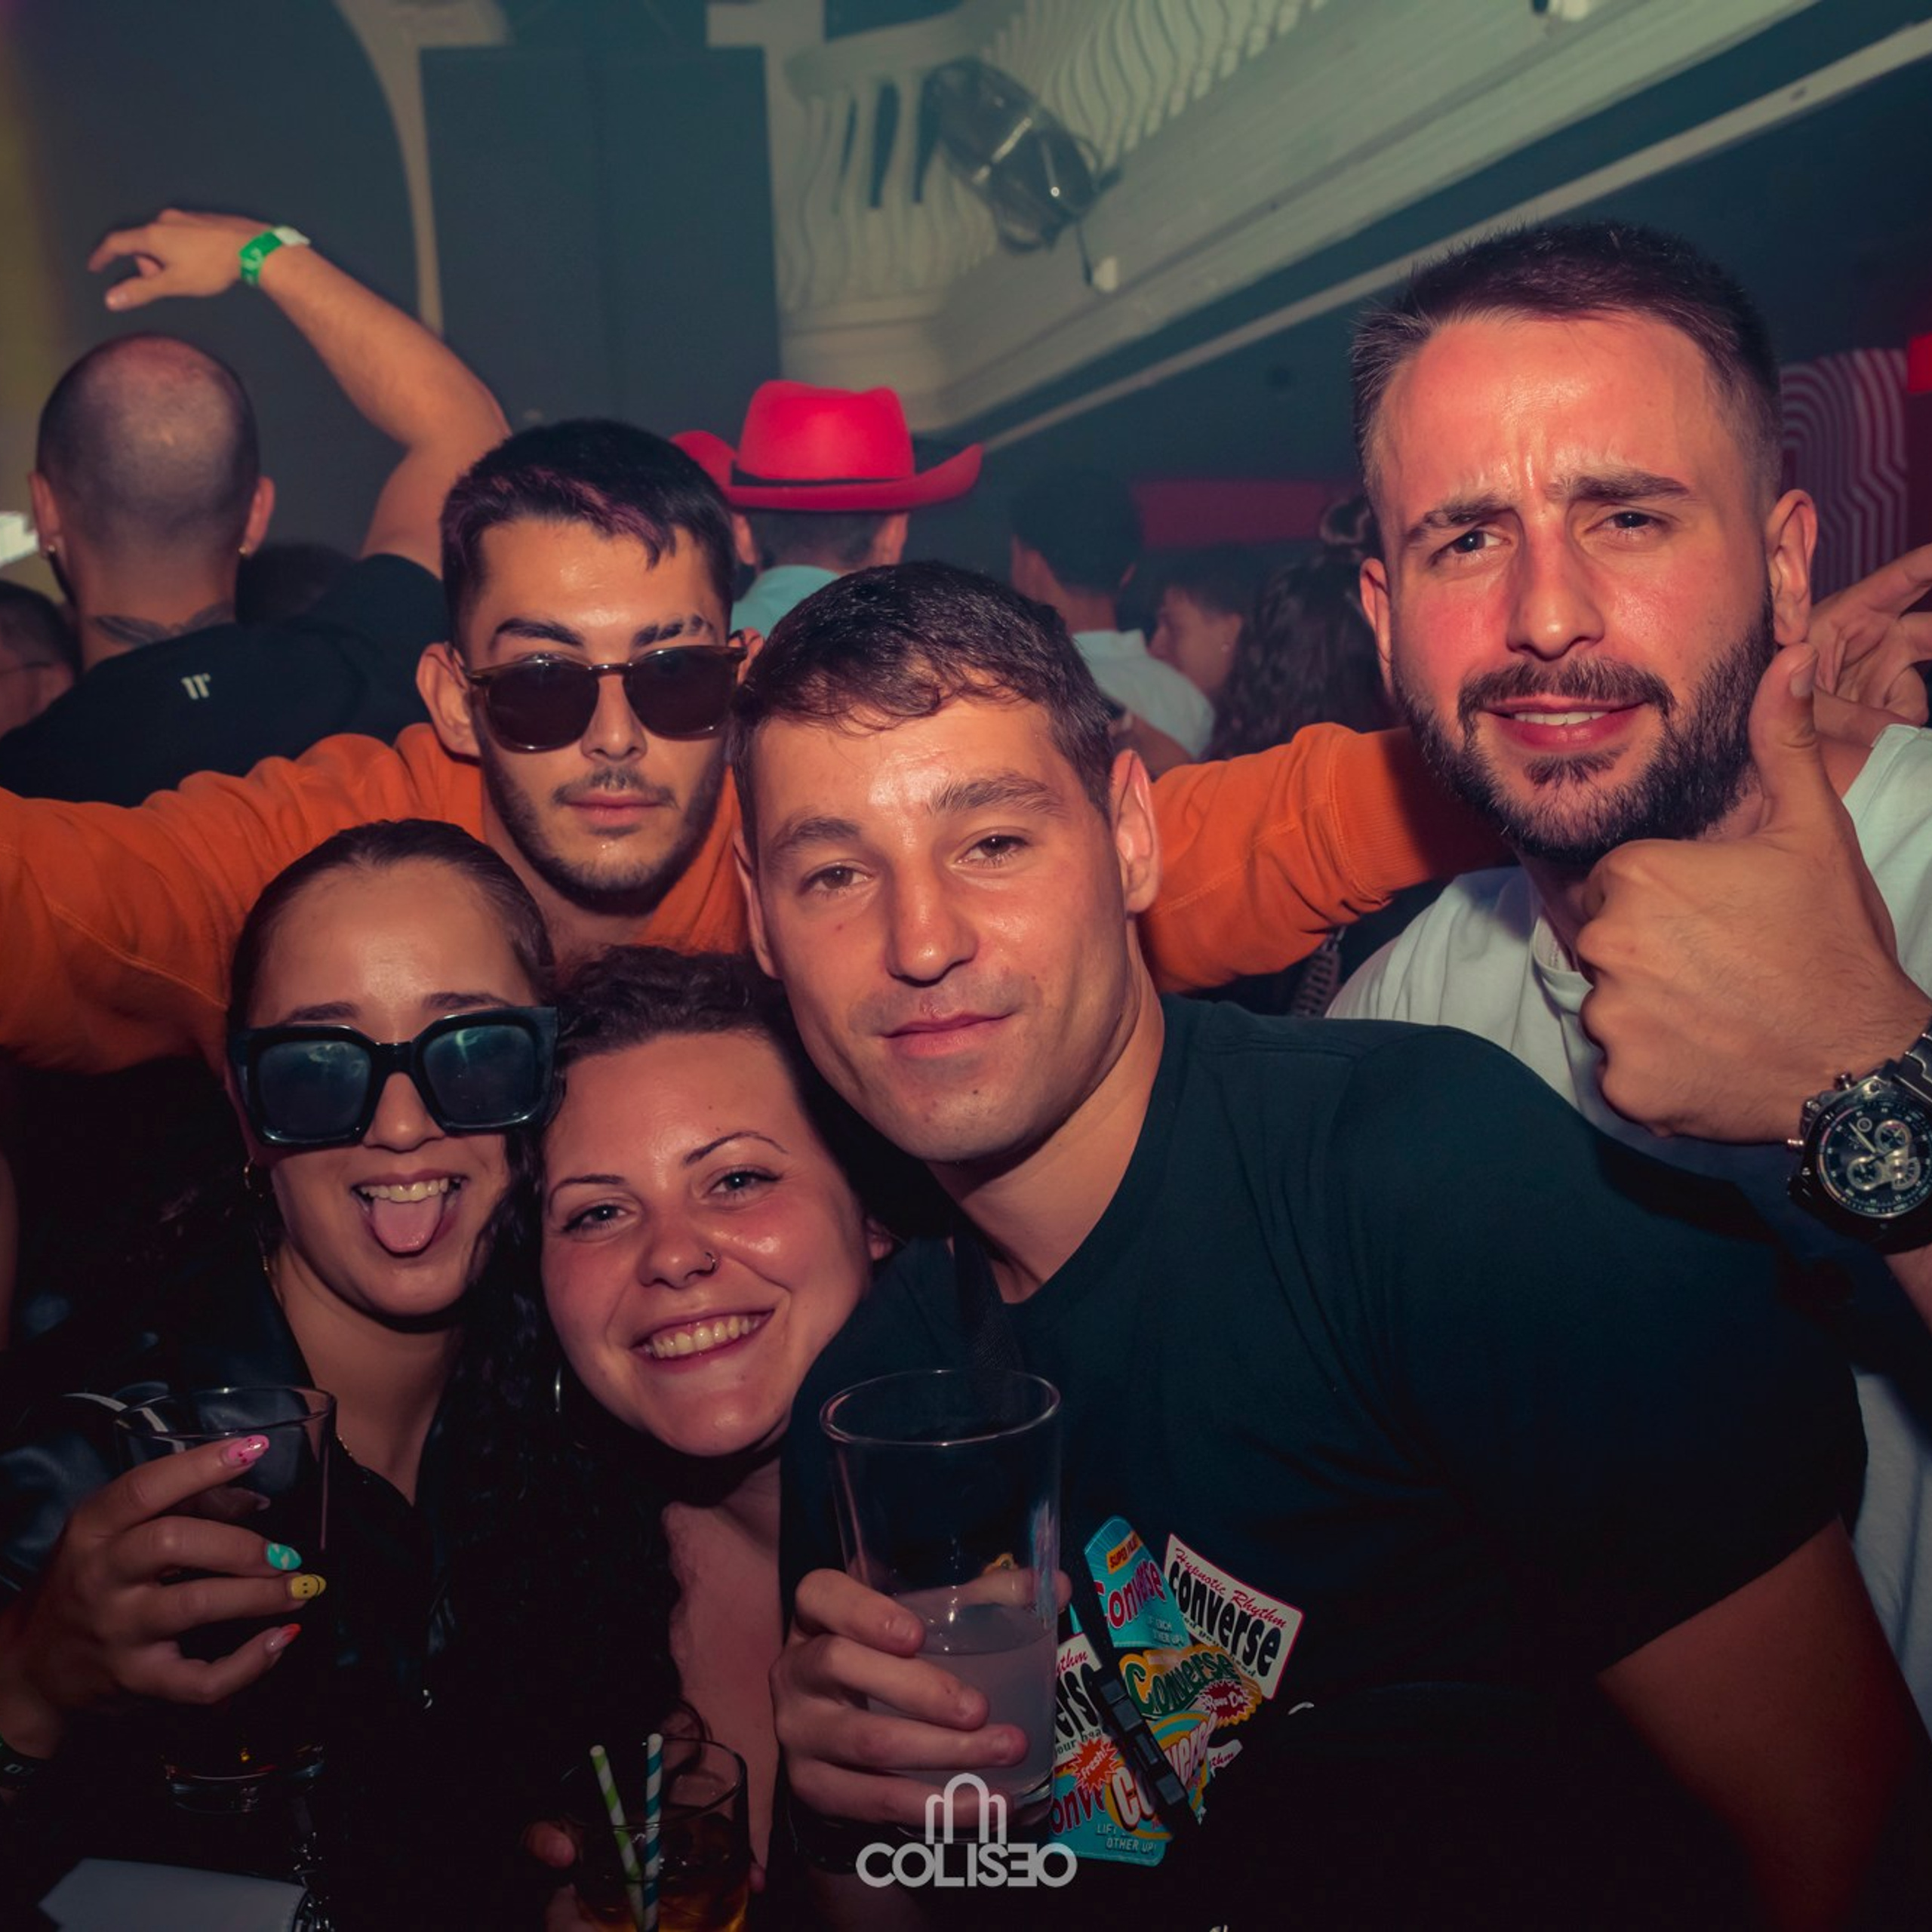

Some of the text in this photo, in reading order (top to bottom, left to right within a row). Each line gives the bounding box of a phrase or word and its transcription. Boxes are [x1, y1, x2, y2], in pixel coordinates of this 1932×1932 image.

[1175, 1547, 1287, 1629] Hypnotic Rhythm
[1106, 1837, 1140, 1854] OTHER
